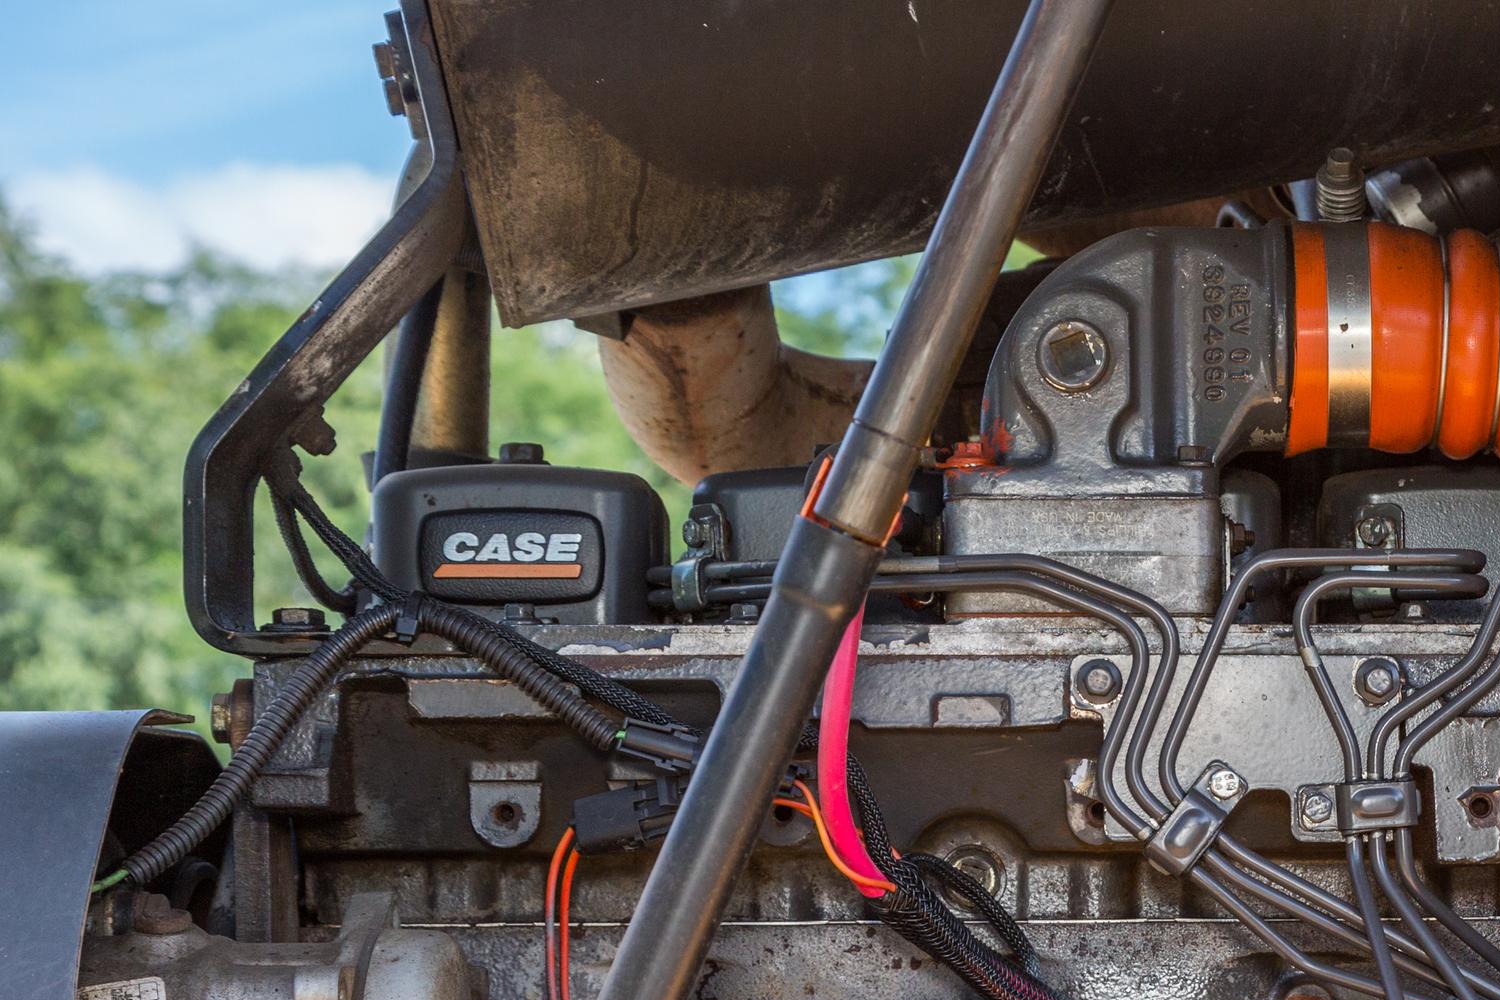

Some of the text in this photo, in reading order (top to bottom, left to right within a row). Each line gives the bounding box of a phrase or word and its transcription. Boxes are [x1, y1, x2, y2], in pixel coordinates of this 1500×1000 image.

[1228, 284, 1251, 336] REV
[1031, 511, 1126, 523] MADE IN USA
[442, 531, 583, 562] CASE
